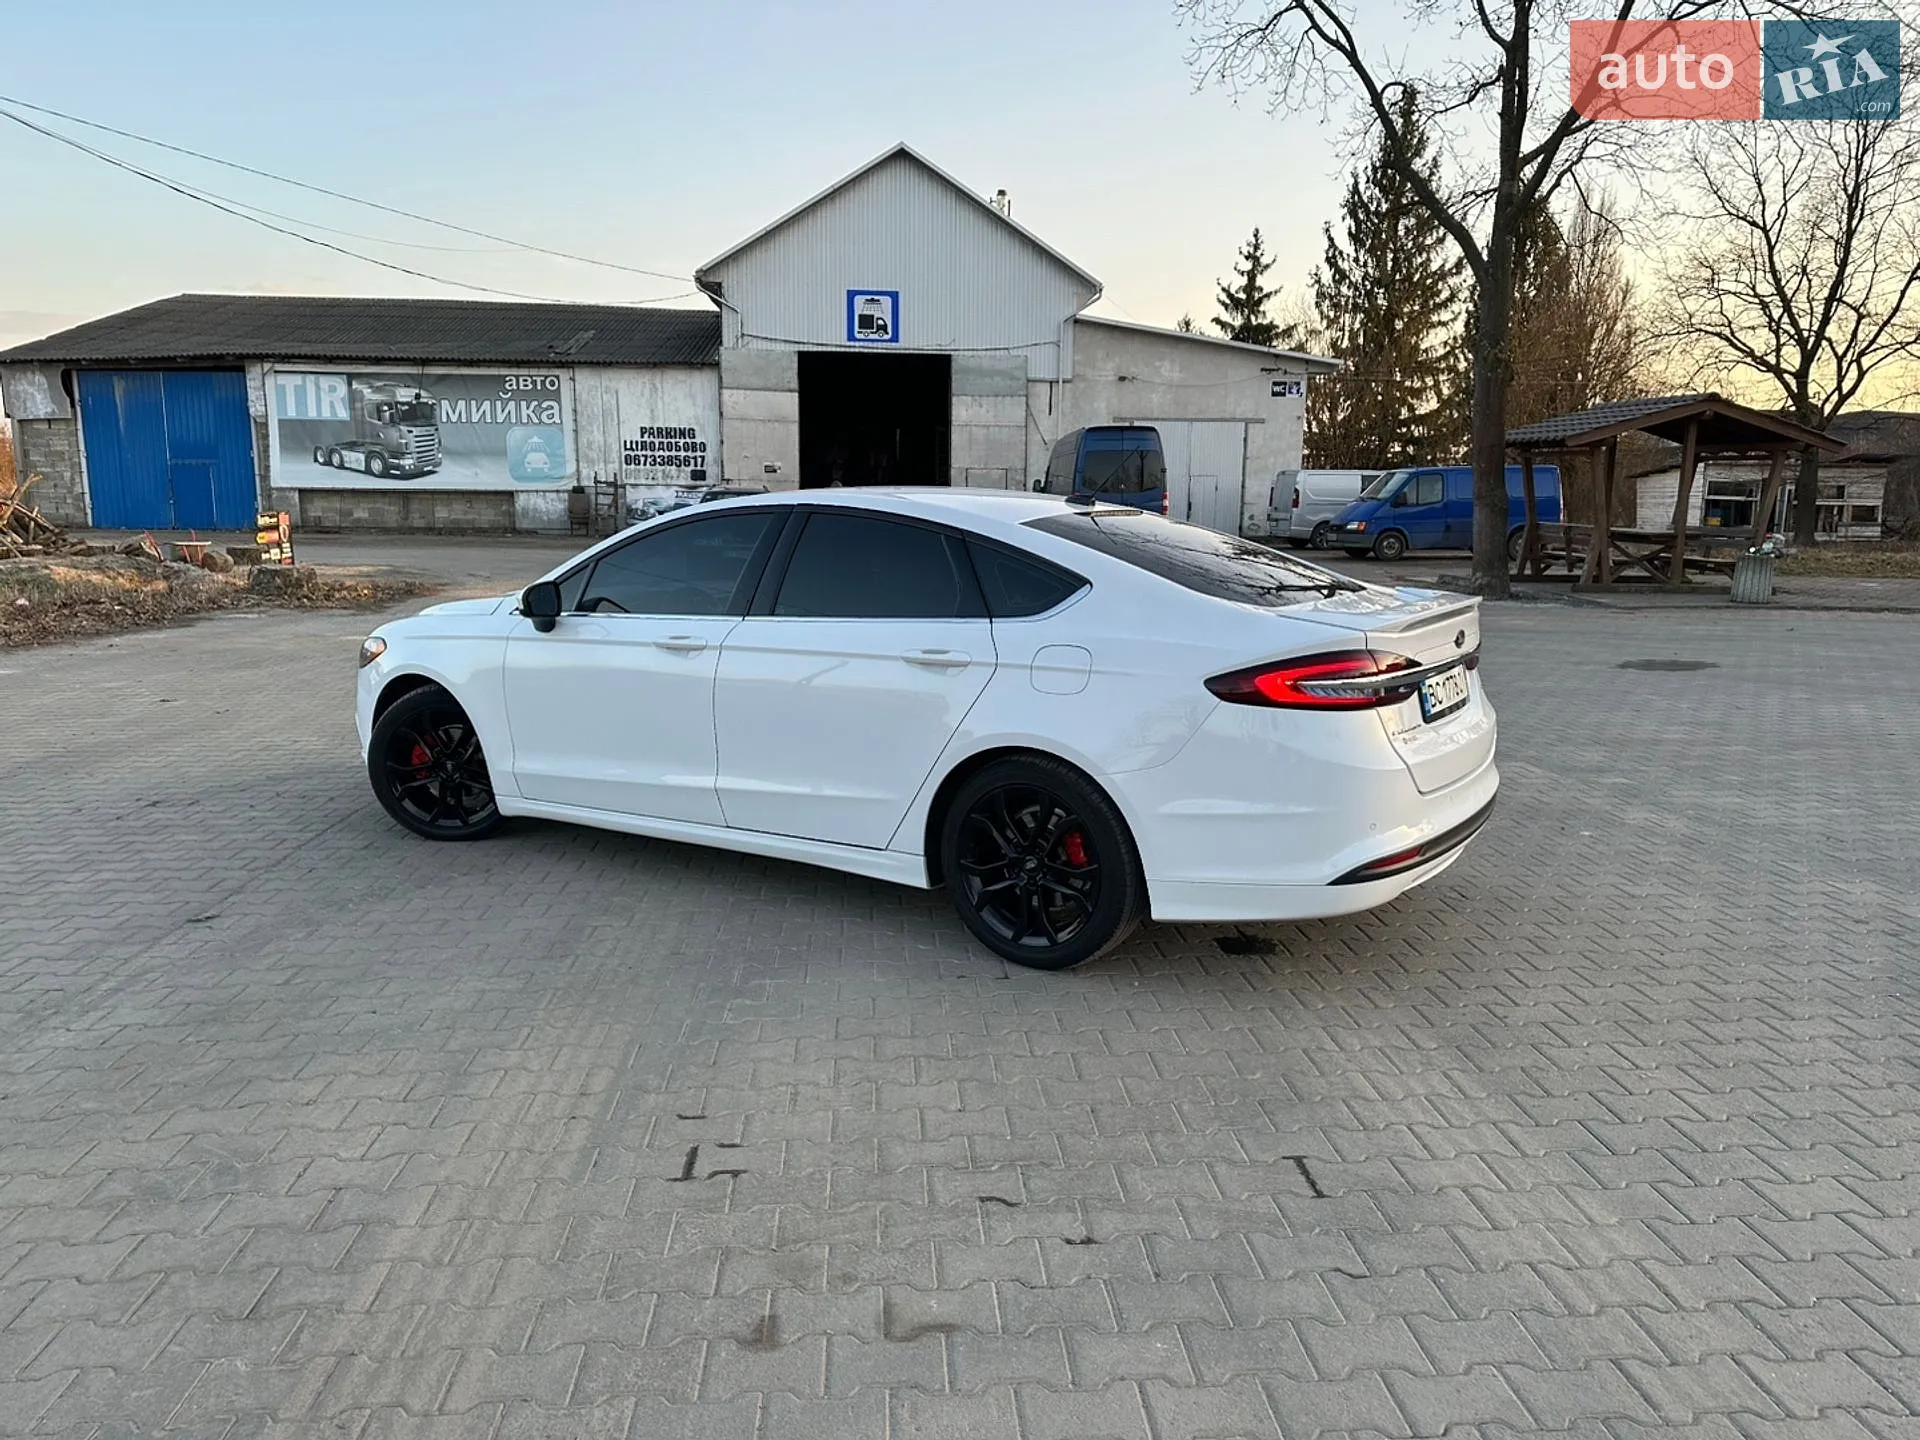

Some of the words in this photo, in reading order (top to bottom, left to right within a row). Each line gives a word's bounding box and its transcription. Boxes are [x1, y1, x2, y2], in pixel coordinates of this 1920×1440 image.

[504, 376, 559, 390] авто
[276, 374, 347, 418] TIR
[441, 391, 561, 424] мийка
[640, 427, 696, 440] PARKING
[624, 454, 706, 468] 0673385617
